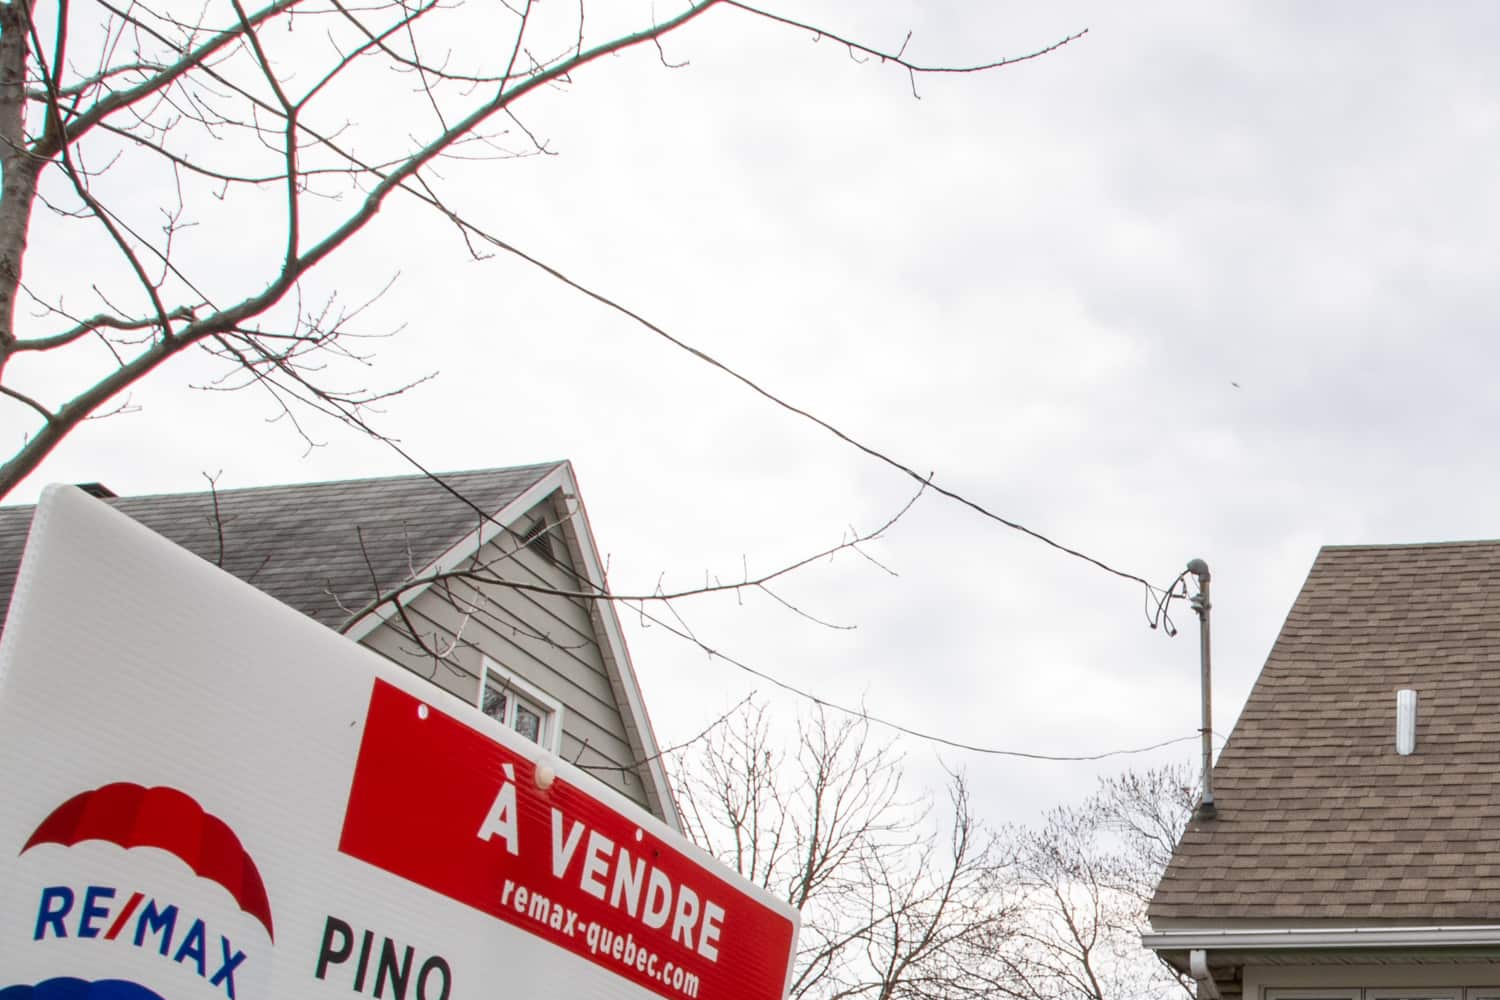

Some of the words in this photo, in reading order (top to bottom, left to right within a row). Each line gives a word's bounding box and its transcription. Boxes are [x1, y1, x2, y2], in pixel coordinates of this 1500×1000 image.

[477, 763, 519, 856] À
[551, 807, 725, 963] VENDRE
[501, 879, 699, 999] remax-quebec.com
